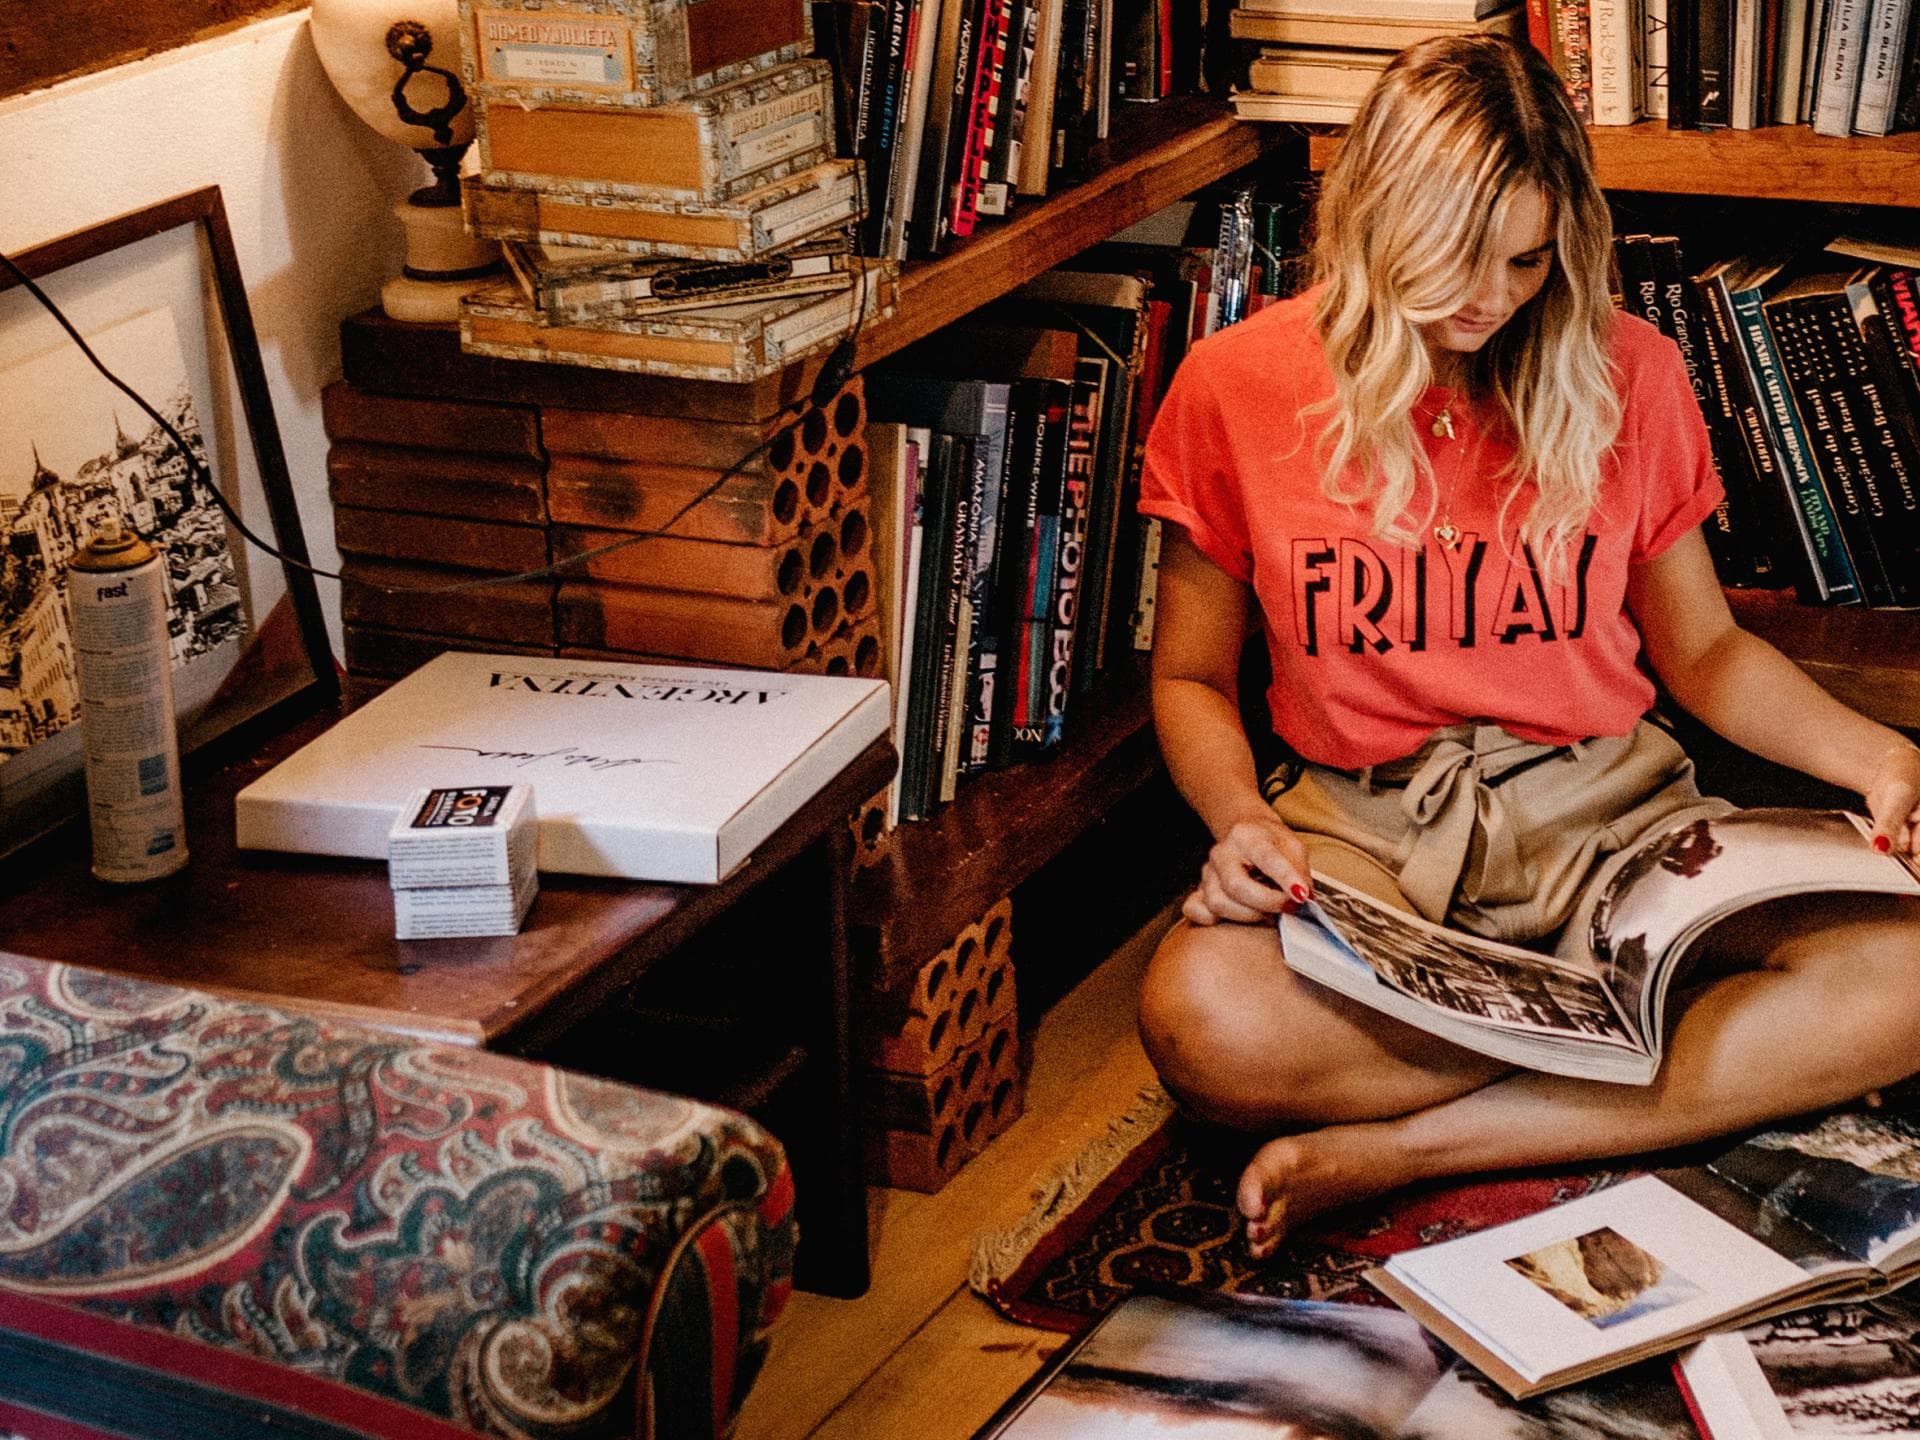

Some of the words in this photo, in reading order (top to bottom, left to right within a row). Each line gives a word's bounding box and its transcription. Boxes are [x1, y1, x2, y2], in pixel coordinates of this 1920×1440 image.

[489, 23, 539, 43] ROMEO
[553, 27, 618, 48] JULIETA
[890, 1, 905, 57] ARENA
[1599, 8, 1615, 38] Rock
[1601, 66, 1617, 93] Roll
[1834, 38, 1847, 81] PLENA
[1876, 36, 1890, 80] PLENA
[1748, 324, 1772, 367] HENRI
[1804, 388, 1832, 431] Brasil
[1829, 390, 1857, 434] Brasil
[1861, 383, 1888, 427] Brasil
[1068, 391, 1099, 475] THE
[1823, 433, 1839, 454] do
[1850, 435, 1864, 456] do
[1881, 429, 1896, 449] do
[1026, 414, 1047, 528] BOURKE-WHITE
[1832, 456, 1860, 516] Coração
[1857, 457, 1885, 518] Coração
[1890, 451, 1917, 511] Coração
[1057, 479, 1087, 626] PHOTO
[1292, 527, 1598, 656] FRIYAY
[488, 672, 790, 705] ARGENTINA
[447, 789, 488, 826] FOTO
